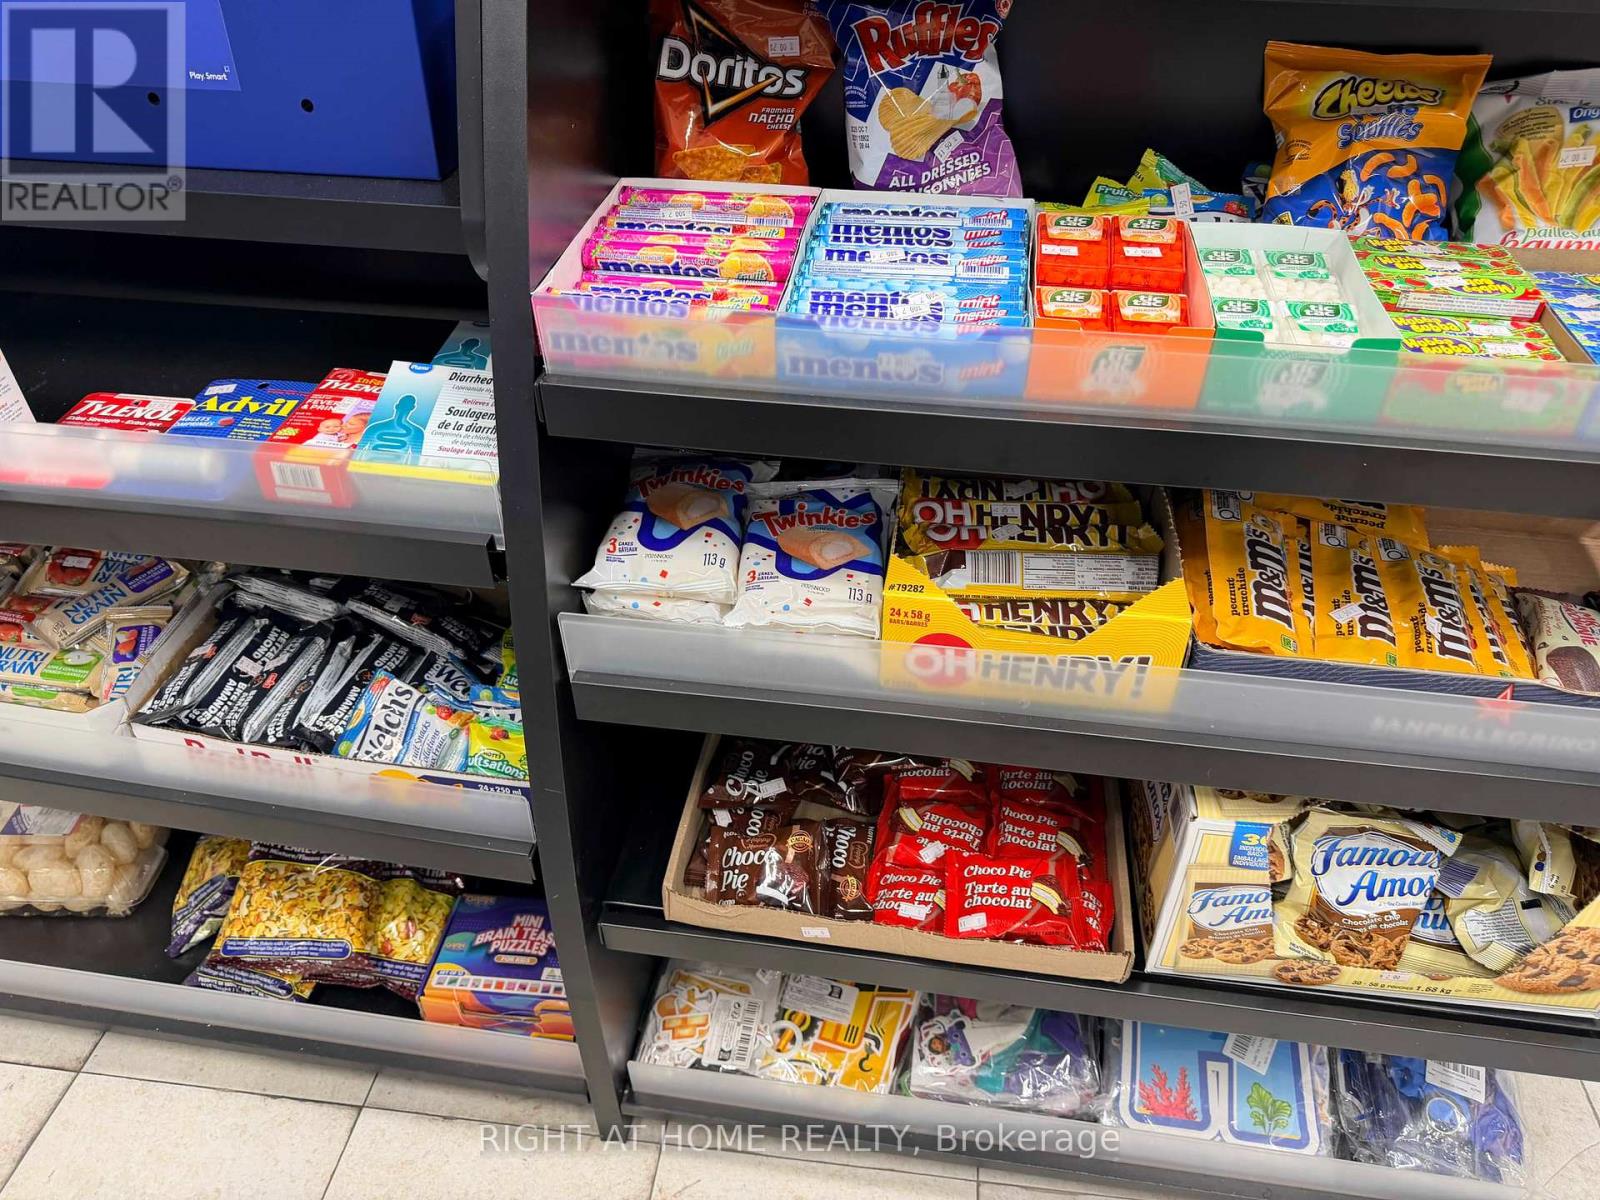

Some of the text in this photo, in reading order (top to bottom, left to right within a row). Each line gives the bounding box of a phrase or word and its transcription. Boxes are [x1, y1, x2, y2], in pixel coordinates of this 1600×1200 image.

[851, 2, 999, 76] Ruffles
[659, 37, 805, 95] Doritos
[1312, 76, 1443, 120] Cheetos
[766, 123, 791, 131] CHEESE
[888, 152, 981, 189] ALL DRESSED
[616, 221, 731, 234] mentos
[830, 224, 952, 240] mentos
[825, 248, 1009, 267] meos menthe
[600, 260, 720, 279] mentos
[591, 286, 713, 302] mentos
[958, 295, 1000, 309] mint
[954, 310, 1008, 322] menthe
[71, 400, 183, 421] TYLENOL
[192, 396, 299, 417] Advil
[437, 419, 451, 430] de
[453, 421, 463, 431] la
[631, 463, 745, 499] Twinkies
[752, 501, 877, 538] Twinkies
[913, 500, 974, 526] OH
[1322, 502, 1387, 521] arachide
[1335, 513, 1386, 530] peanut
[606, 537, 617, 553] 3
[703, 553, 726, 568] 113 g
[745, 570, 757, 583] 3
[848, 587, 863, 602] 113
[888, 583, 925, 593] #79282
[1226, 577, 1240, 617] peanut
[1236, 567, 1250, 616] arachide
[63, 582, 118, 619] NUTRI
[70, 587, 127, 626] GRAIN
[889, 607, 931, 622] 24 x 58 g
[1410, 615, 1425, 653] peanut
[904, 647, 1152, 700] OH HENRY!
[727, 750, 755, 797] Choco
[495, 786, 511, 794] 250
[923, 811, 984, 838] chocolat
[1038, 814, 1058, 827] Pie
[943, 829, 981, 851] Tarte
[1038, 831, 1057, 843] au
[1311, 837, 1441, 876] Famous
[720, 869, 750, 893] Pie
[880, 873, 942, 886] Choco Pie
[964, 865, 1032, 879] Choco Pie
[877, 888, 935, 902] Tarte au
[964, 881, 1031, 897] Tarte au
[1335, 869, 1437, 907] Amos
[964, 895, 1033, 909] chocolat
[513, 914, 544, 928] MINI
[473, 926, 520, 947] BRAIN
[489, 940, 550, 956] PUZZLES
